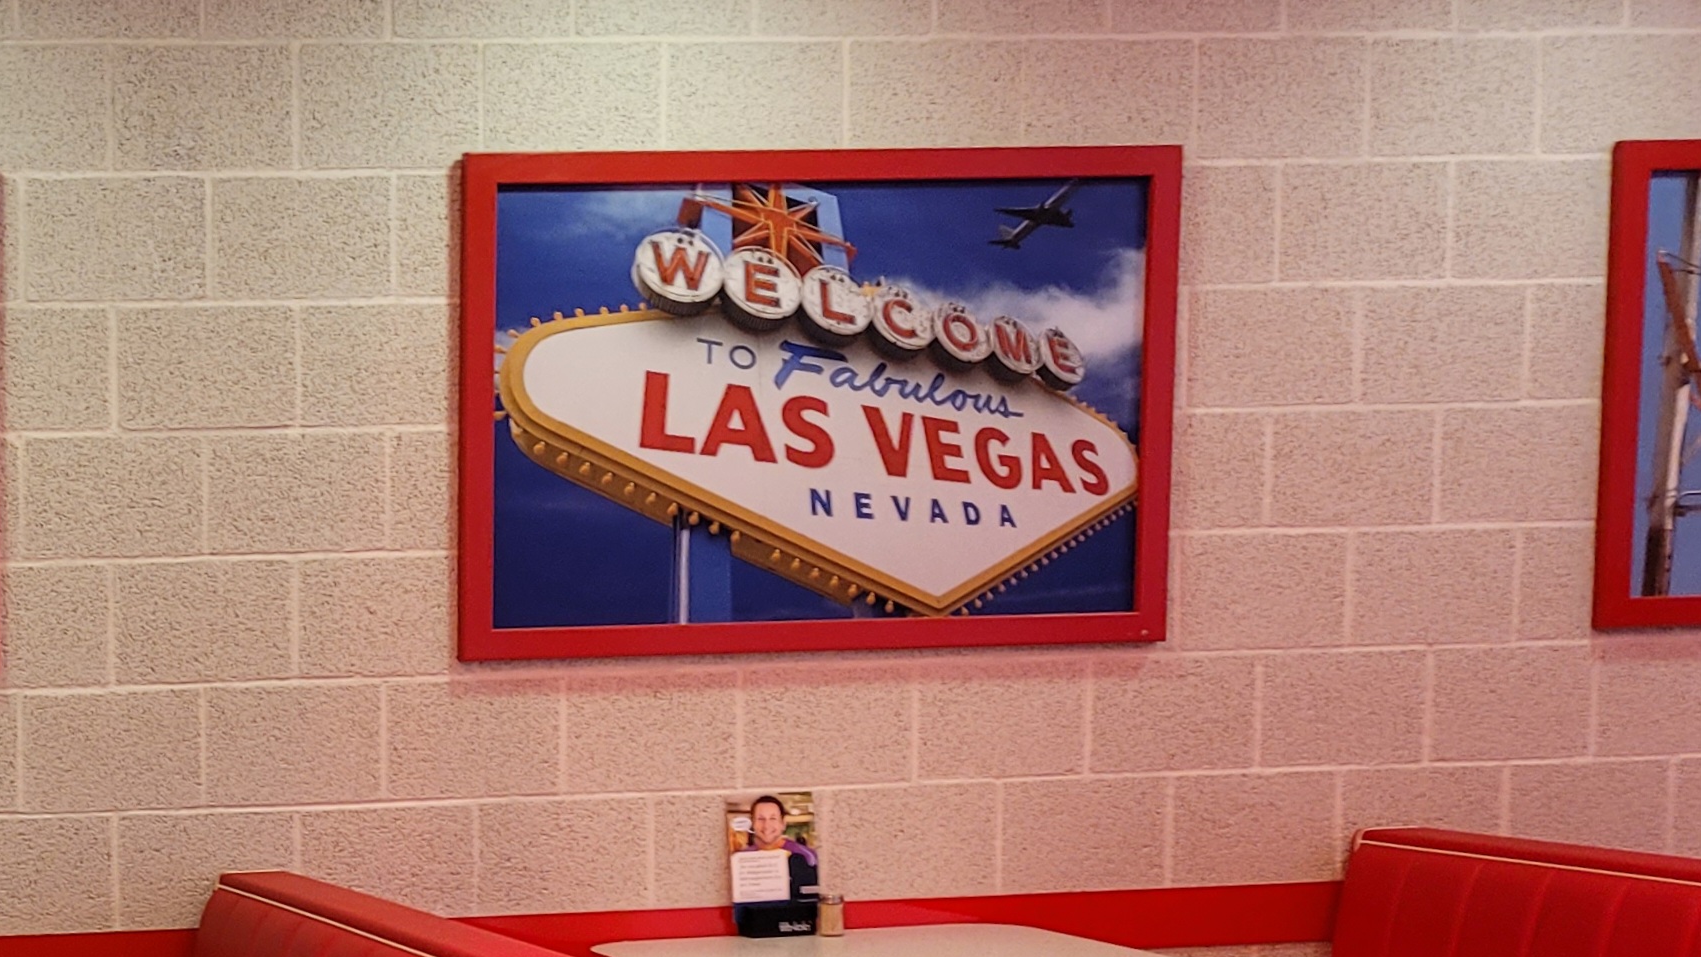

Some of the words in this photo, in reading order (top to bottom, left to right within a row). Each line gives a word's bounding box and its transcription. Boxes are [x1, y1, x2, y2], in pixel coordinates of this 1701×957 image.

[651, 238, 1078, 374] WELCOME
[698, 337, 758, 370] TO
[773, 339, 1025, 419] Fabulous
[639, 369, 836, 469] LAS
[860, 403, 1110, 497] VEGAS
[809, 487, 1018, 528] NEVADA
